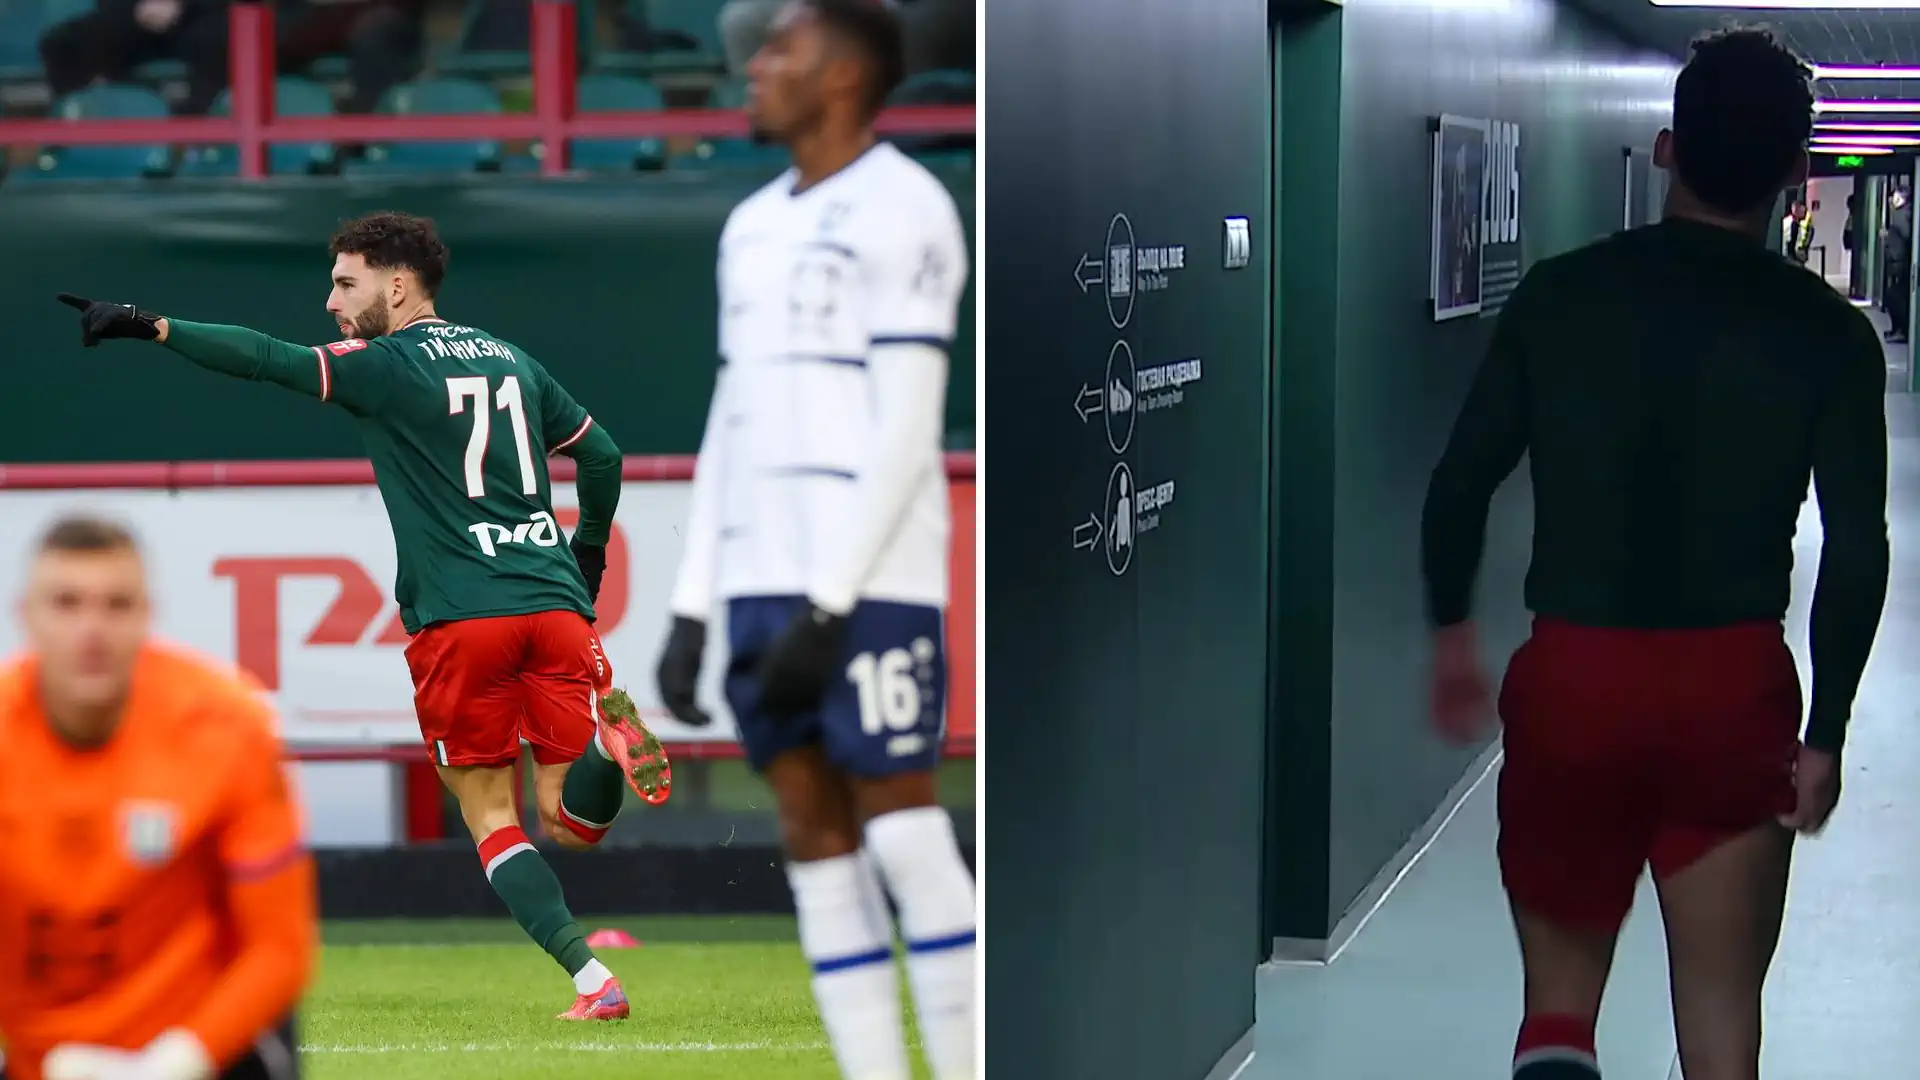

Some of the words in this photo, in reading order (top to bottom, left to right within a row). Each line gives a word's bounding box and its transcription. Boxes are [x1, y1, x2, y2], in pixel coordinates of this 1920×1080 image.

[1482, 118, 1519, 244] 2005
[445, 375, 537, 499] 71
[846, 647, 920, 736] 16
